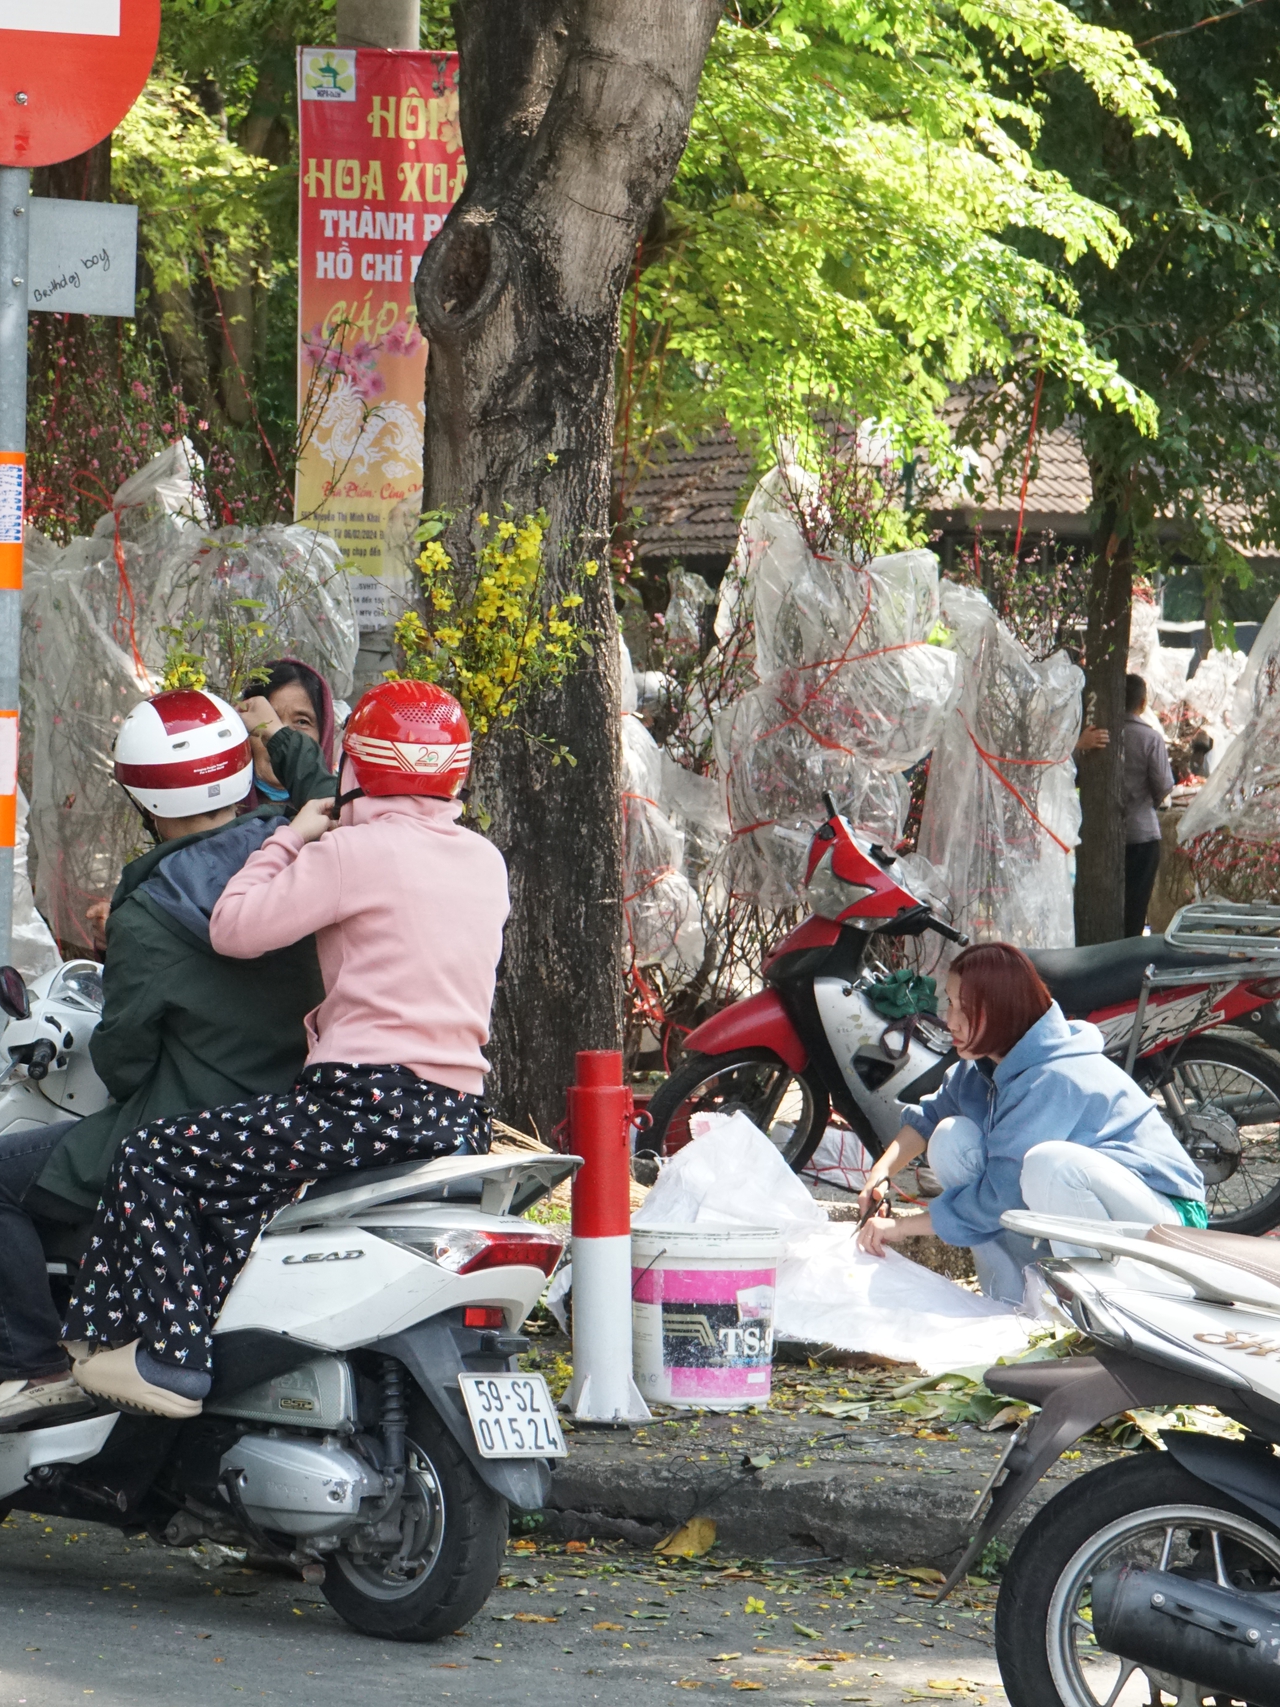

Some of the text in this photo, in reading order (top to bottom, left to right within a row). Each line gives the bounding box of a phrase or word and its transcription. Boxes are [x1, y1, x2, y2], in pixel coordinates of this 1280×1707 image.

[304, 158, 385, 200] HOA
[320, 205, 415, 241] THÀNH
[81, 248, 110, 272] boy
[316, 241, 353, 279] HỒ
[361, 249, 403, 282] CHÍ
[282, 1249, 366, 1265] LEAD
[474, 1380, 541, 1413] 59-S2
[478, 1417, 559, 1451] 015.24
